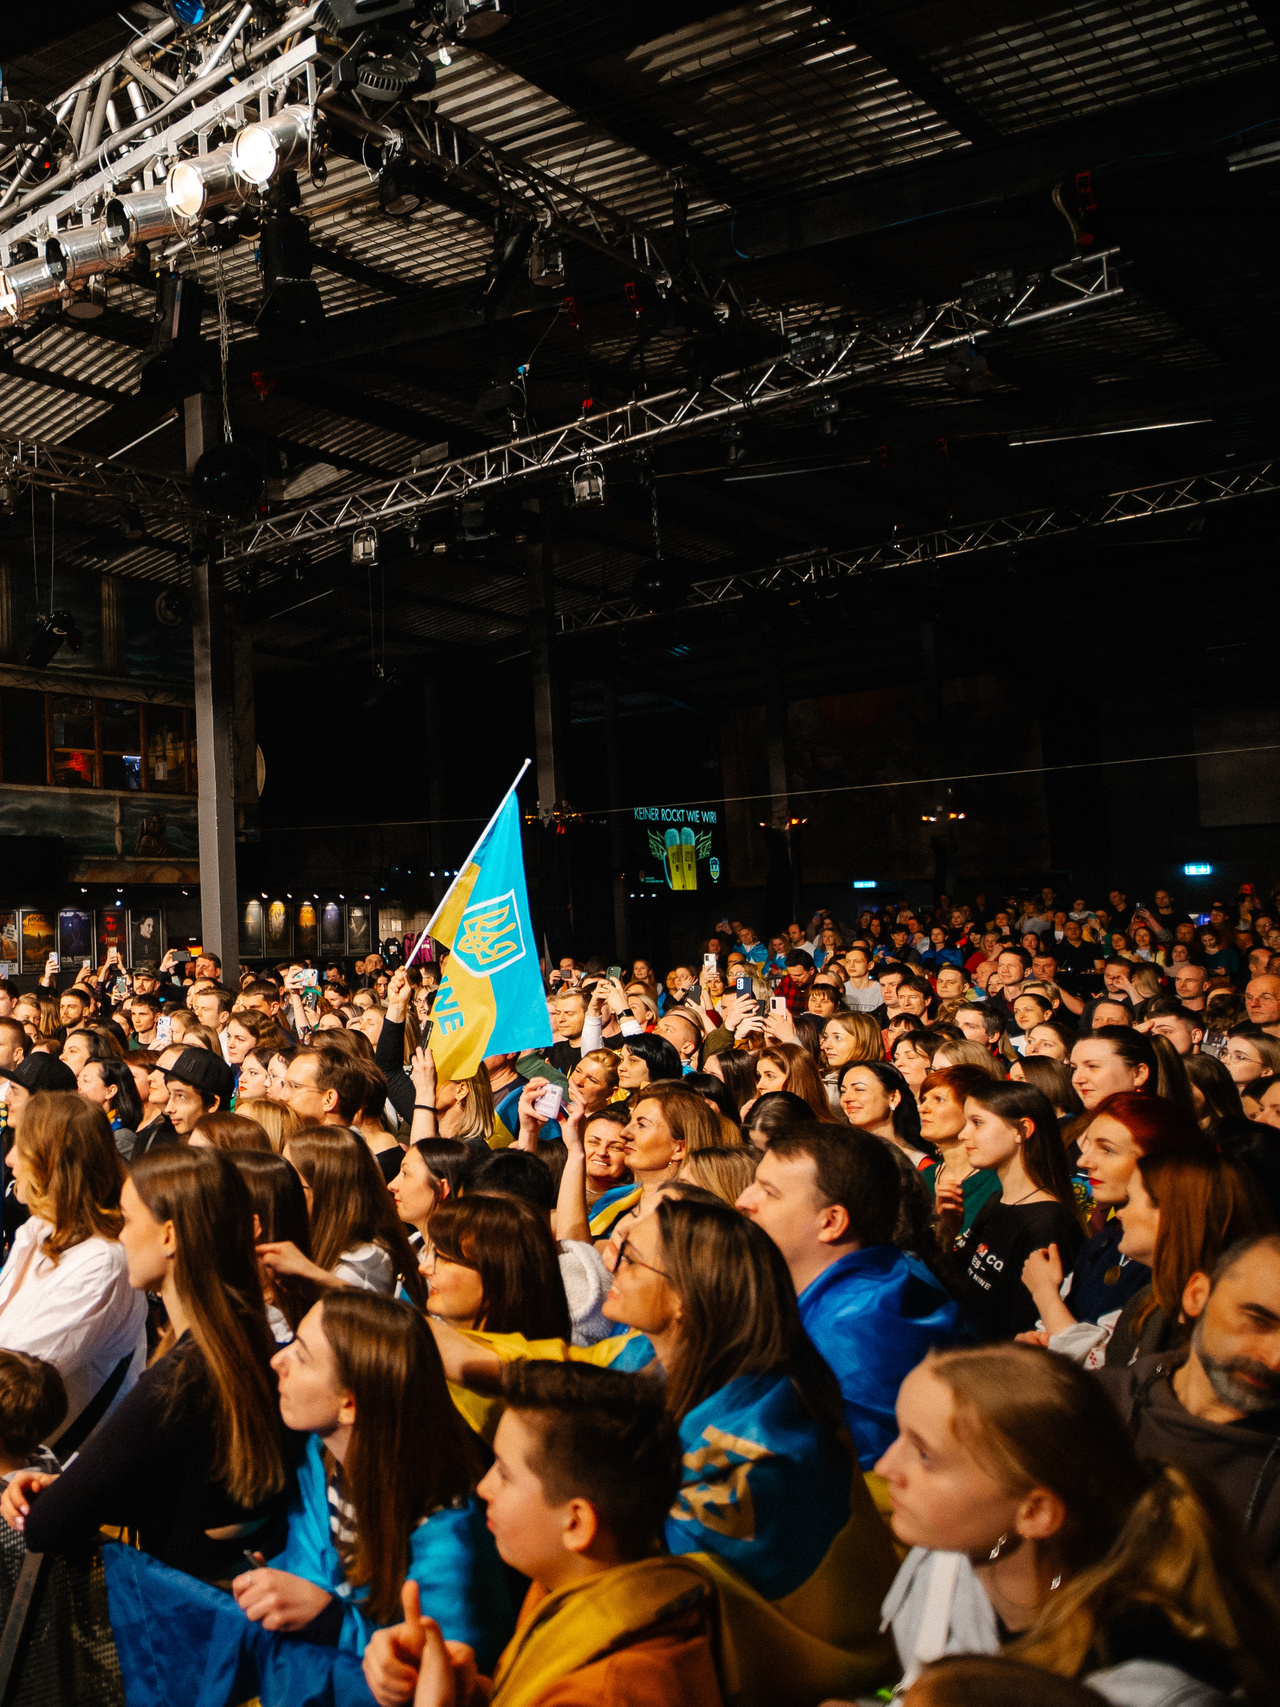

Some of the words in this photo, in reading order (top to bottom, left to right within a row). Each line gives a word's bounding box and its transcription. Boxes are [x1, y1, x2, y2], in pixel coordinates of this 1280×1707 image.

[634, 807, 659, 820] KEINER
[661, 808, 684, 822] ROCKT
[686, 809, 700, 823] WIE
